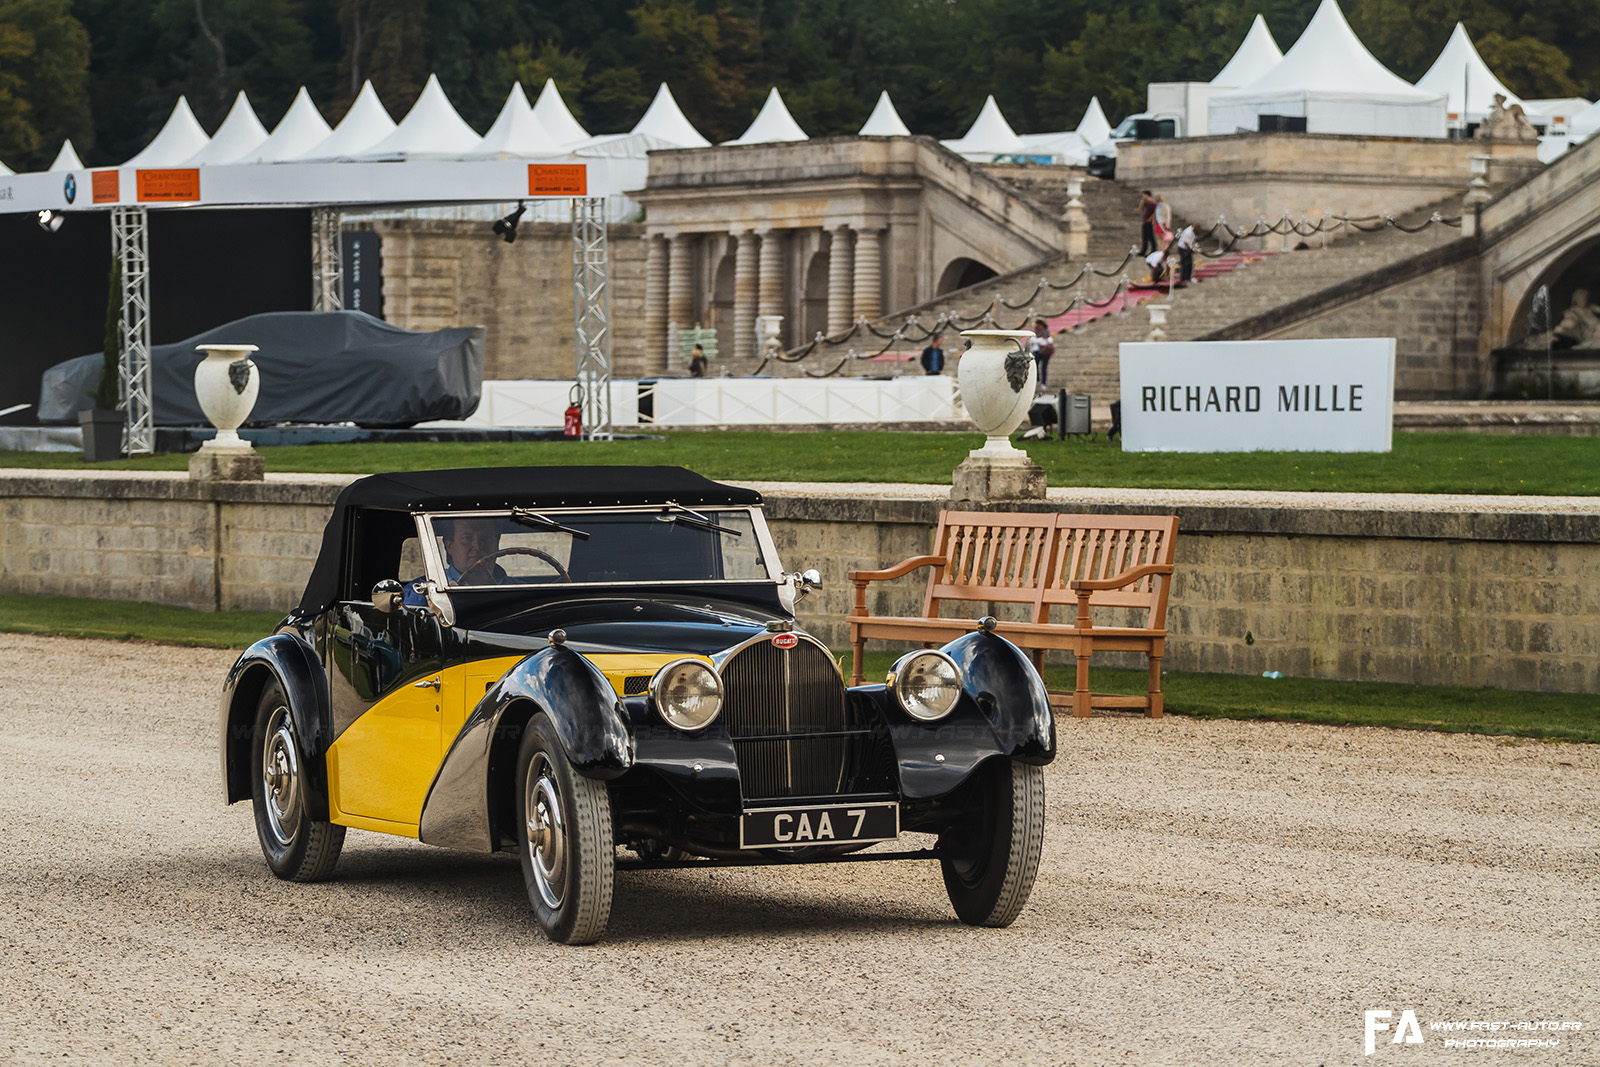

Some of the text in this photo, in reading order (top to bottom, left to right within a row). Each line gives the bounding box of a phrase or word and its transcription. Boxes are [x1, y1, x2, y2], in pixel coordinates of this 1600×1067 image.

[1142, 384, 1363, 413] RICHARD MILLE
[774, 809, 866, 842] CAA 7
